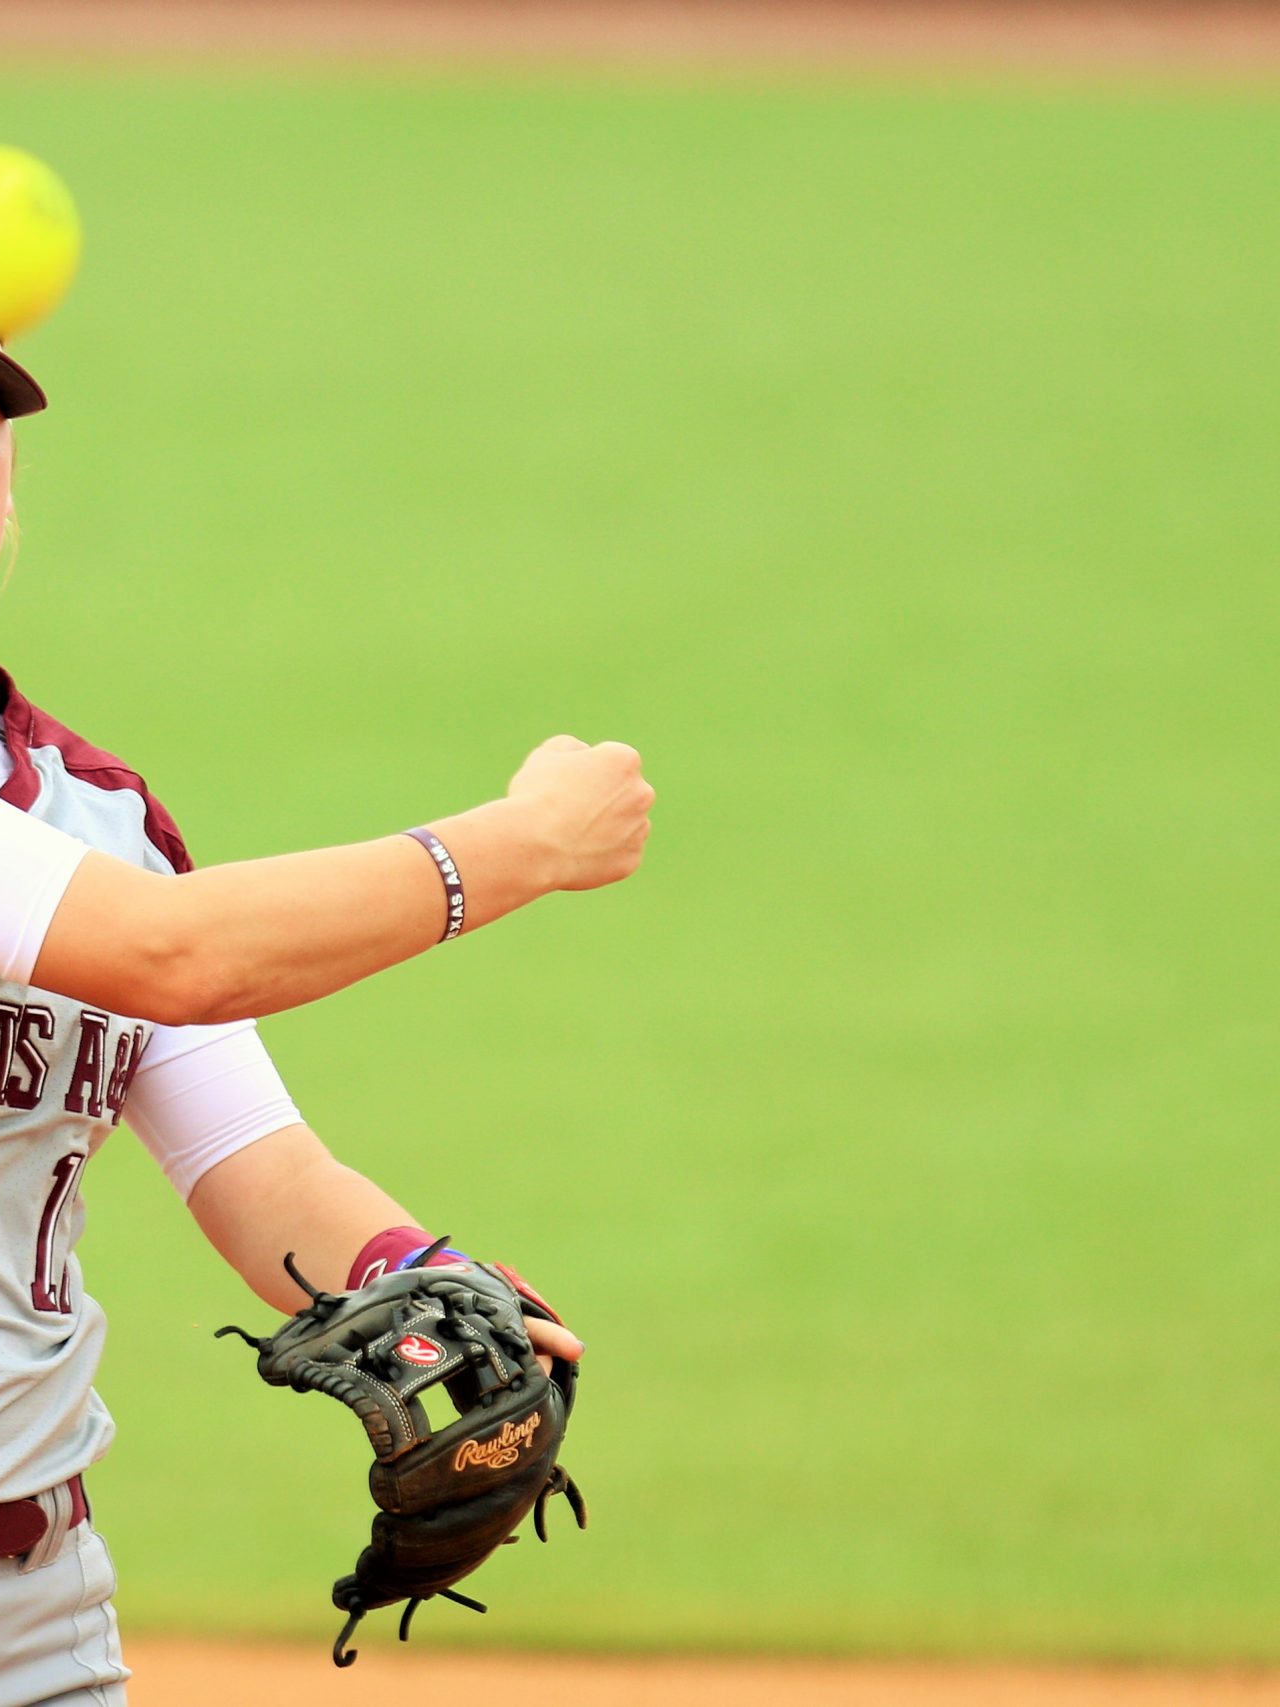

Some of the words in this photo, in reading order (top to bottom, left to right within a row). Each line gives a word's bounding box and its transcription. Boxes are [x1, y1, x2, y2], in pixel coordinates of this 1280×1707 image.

[64, 1009, 154, 1126] A&
[31, 1152, 85, 1314] 1
[455, 1411, 541, 1471] Rawlings
